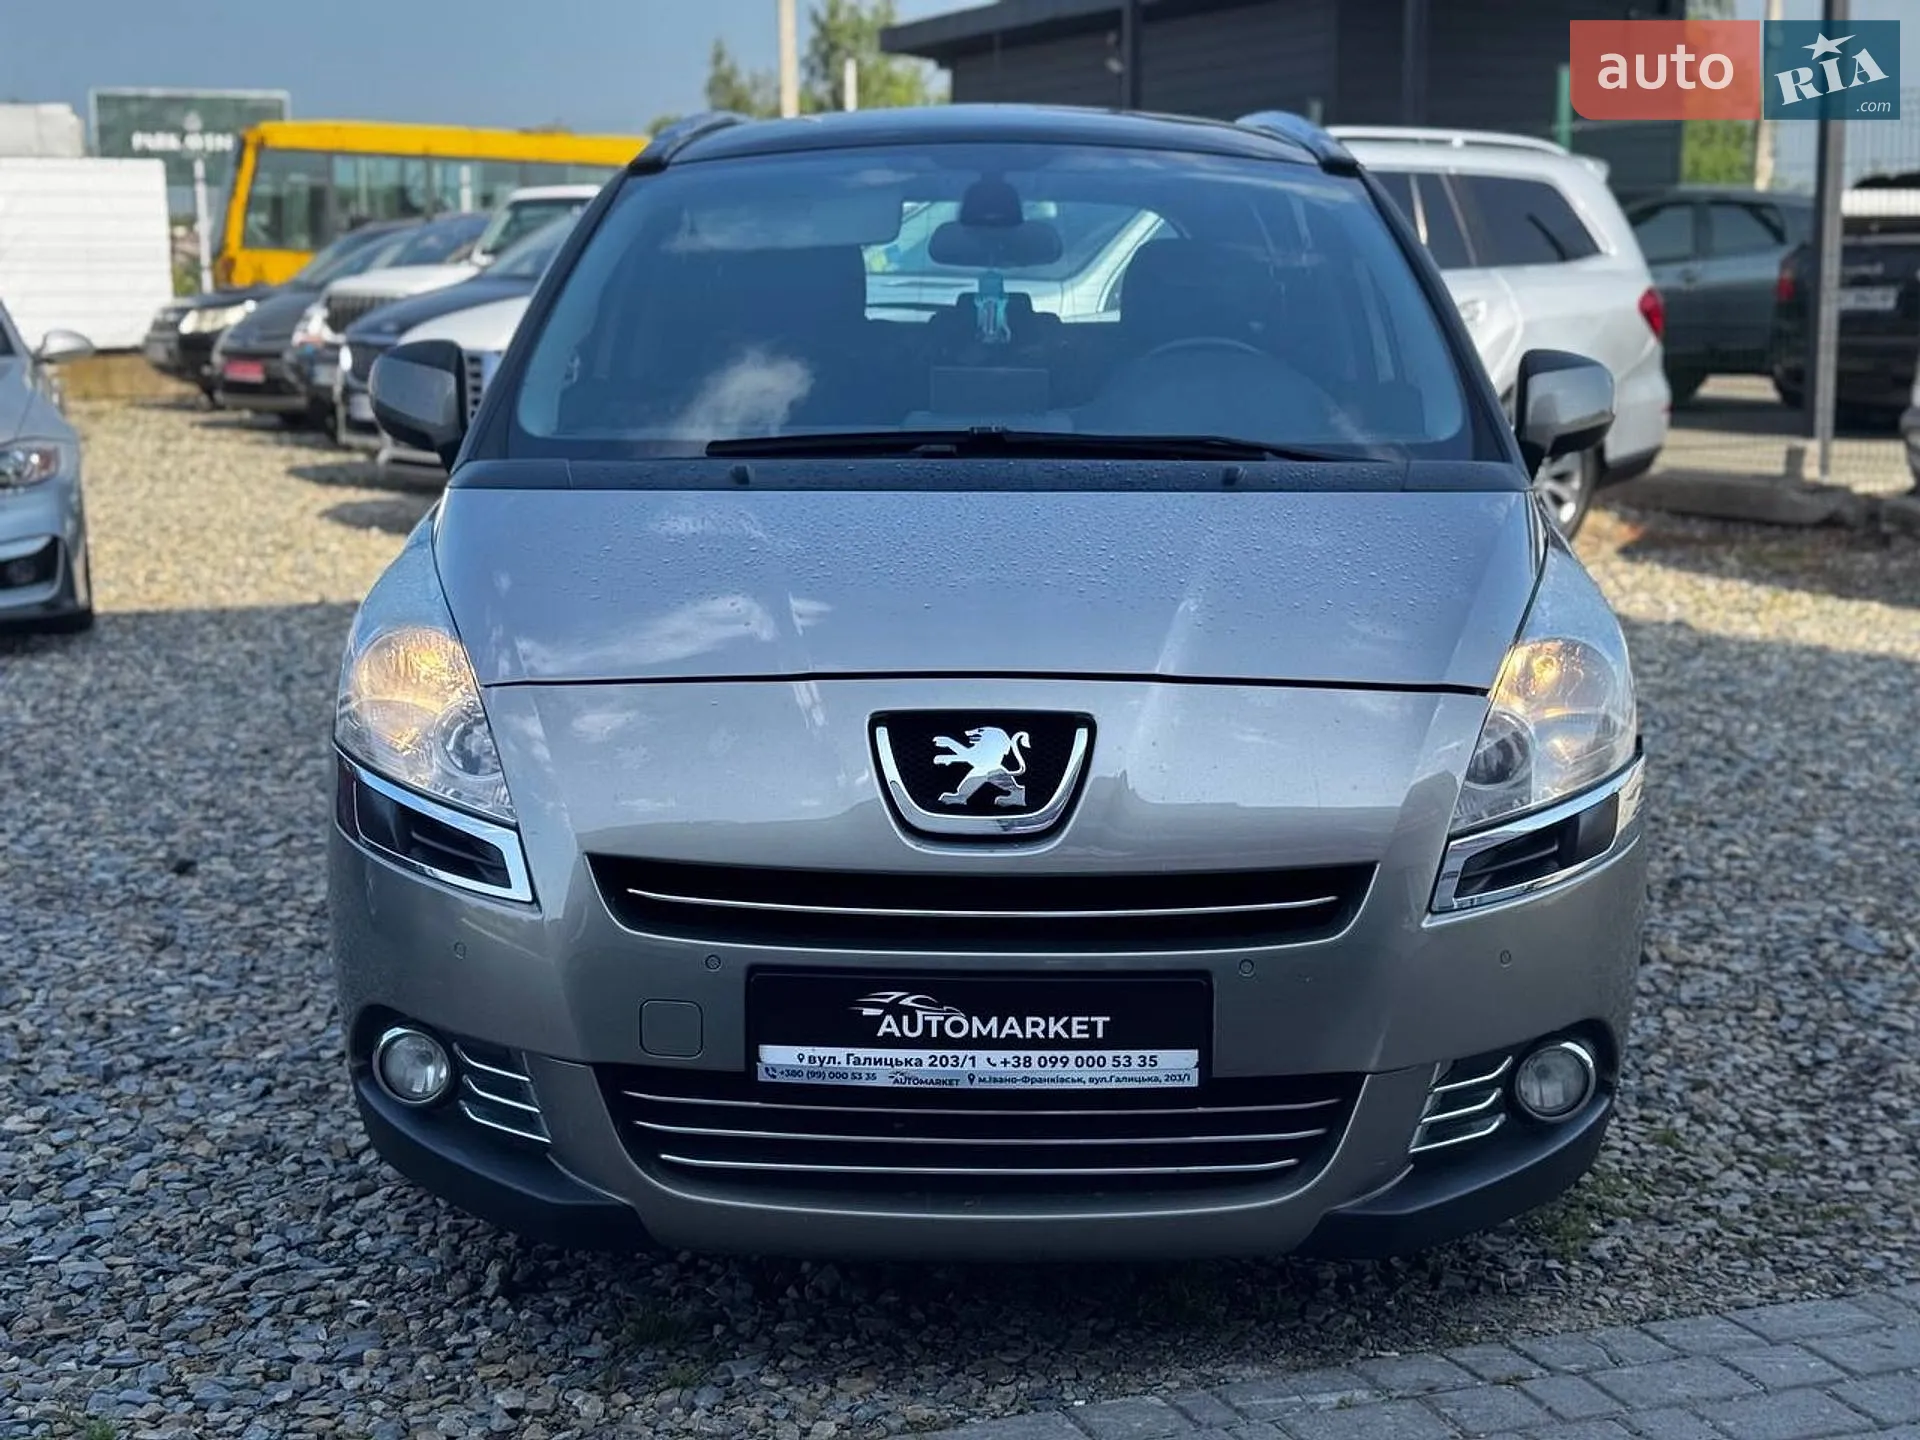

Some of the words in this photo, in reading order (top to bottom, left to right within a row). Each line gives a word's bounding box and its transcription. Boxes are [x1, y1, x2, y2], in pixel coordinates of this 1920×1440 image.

[876, 1010, 1111, 1039] AUTOMARKET
[808, 1054, 841, 1067] вул.
[846, 1053, 923, 1068] Галицька
[928, 1055, 977, 1068] 203/1
[1001, 1055, 1032, 1068] +38
[1037, 1055, 1069, 1068] 099
[1074, 1055, 1106, 1068] 000
[1111, 1055, 1132, 1068] 53
[1137, 1055, 1158, 1068] 35
[828, 1072, 848, 1080] 000
[893, 1076, 960, 1086] AUTOMARKET
